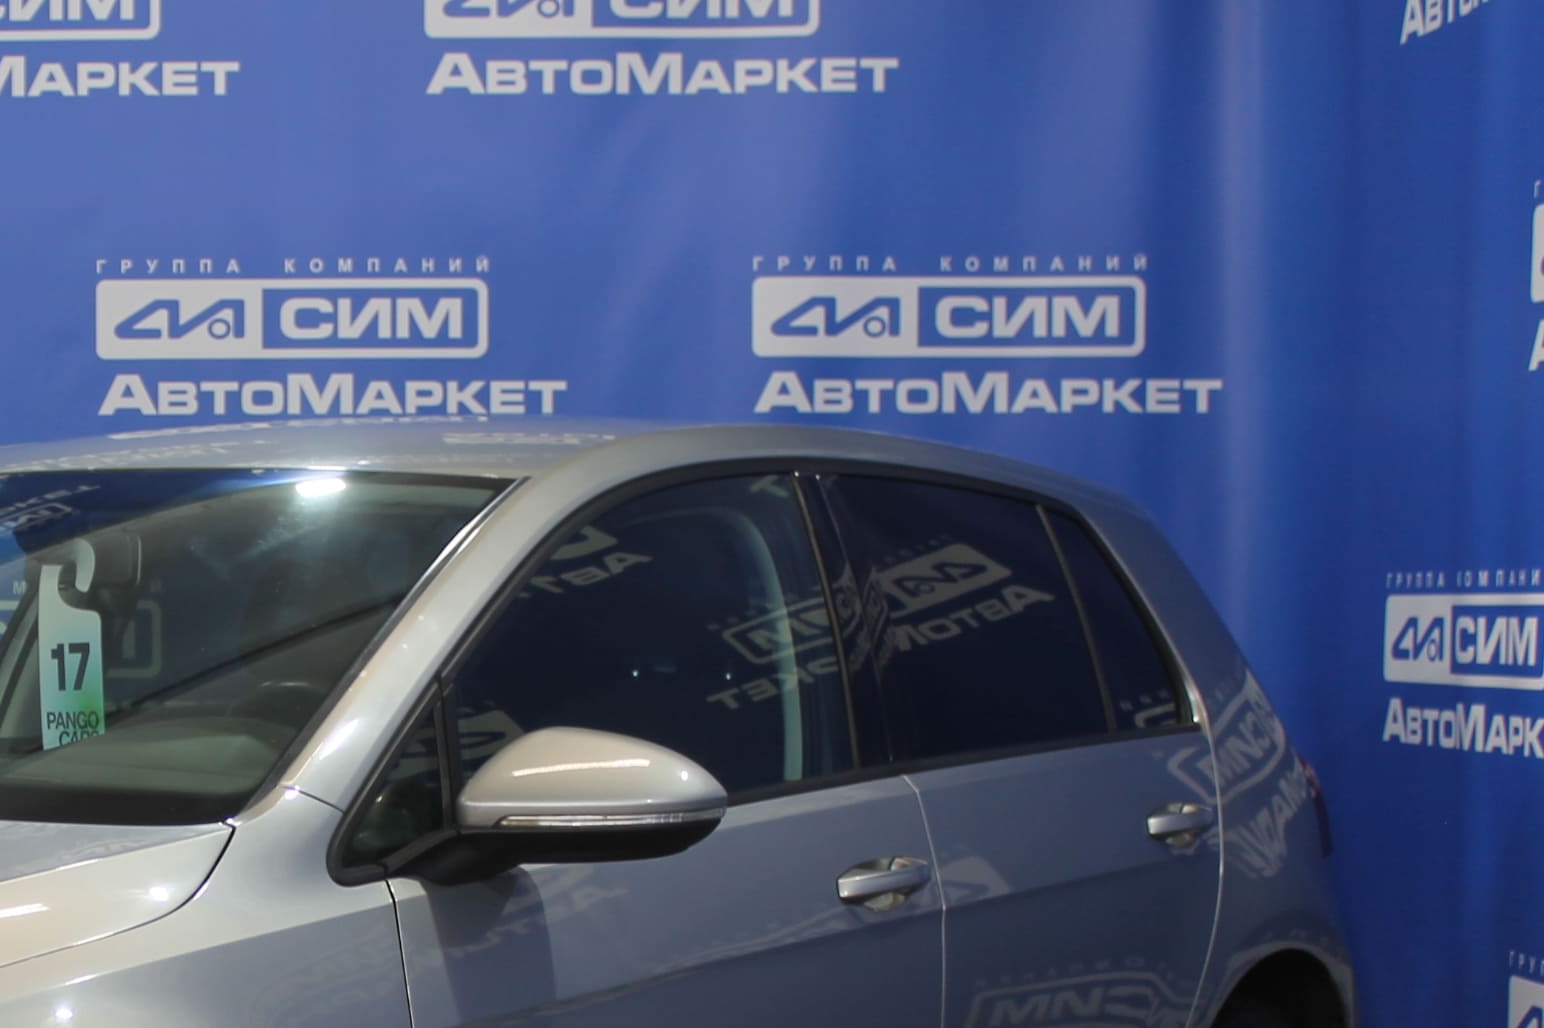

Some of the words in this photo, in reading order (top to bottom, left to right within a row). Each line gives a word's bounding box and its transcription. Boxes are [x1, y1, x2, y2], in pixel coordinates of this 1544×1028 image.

[96, 258, 240, 274] ГРУППА
[284, 256, 489, 273] КОМПАНИЙ
[752, 255, 896, 272] ГРУППА
[940, 254, 1147, 272] КОМПАНИЙ
[280, 297, 463, 339] СИМ
[935, 295, 1120, 338] СИМ
[1456, 616, 1539, 666] СИМ
[50, 642, 90, 692] 17
[46, 711, 99, 730] PANGO
